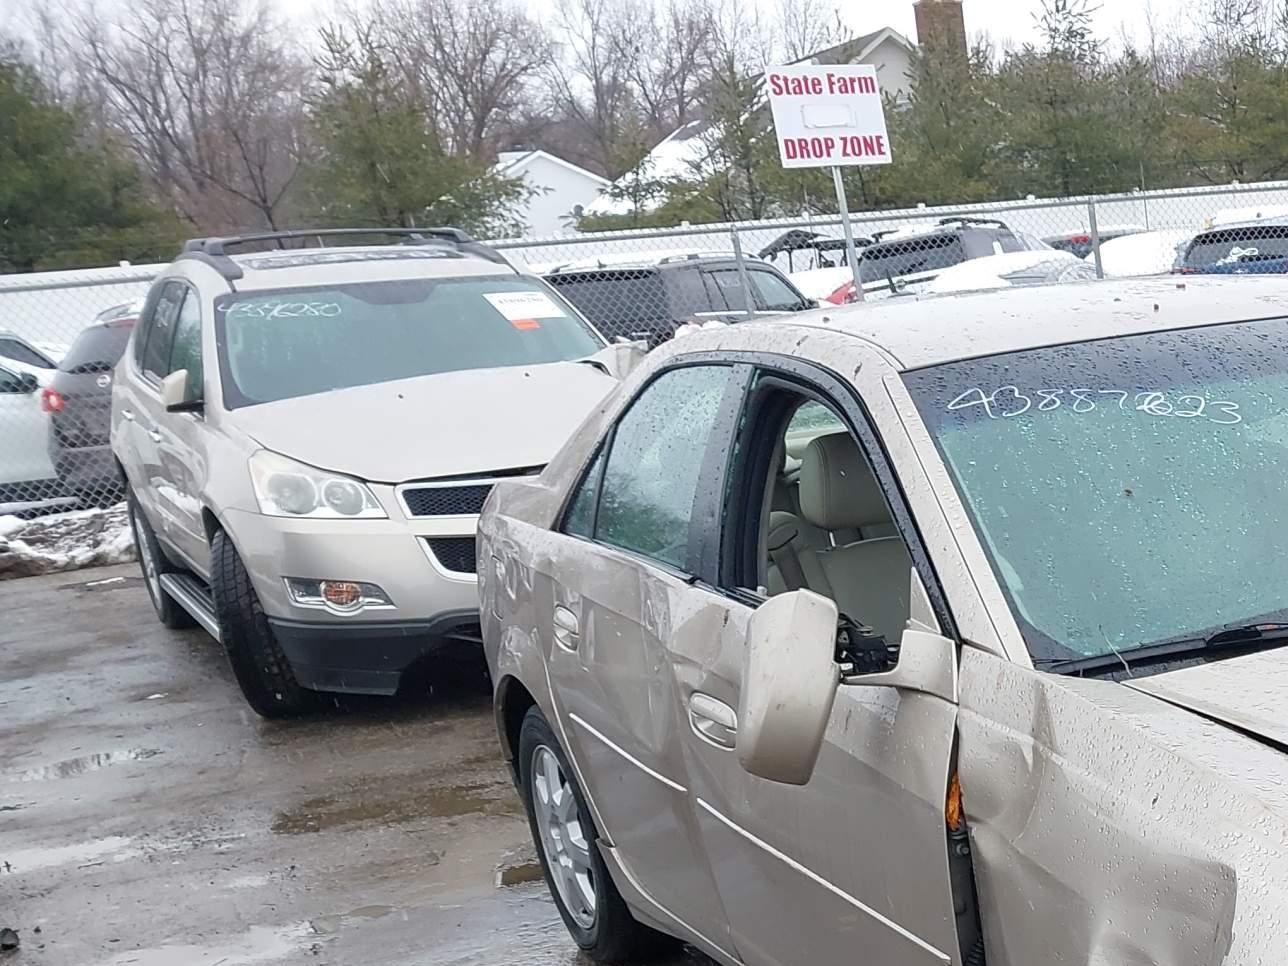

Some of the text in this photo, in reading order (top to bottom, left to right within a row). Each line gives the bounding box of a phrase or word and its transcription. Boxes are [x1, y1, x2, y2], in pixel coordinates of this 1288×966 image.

[769, 73, 876, 96] State Farm
[784, 135, 886, 160] DROP ZONE
